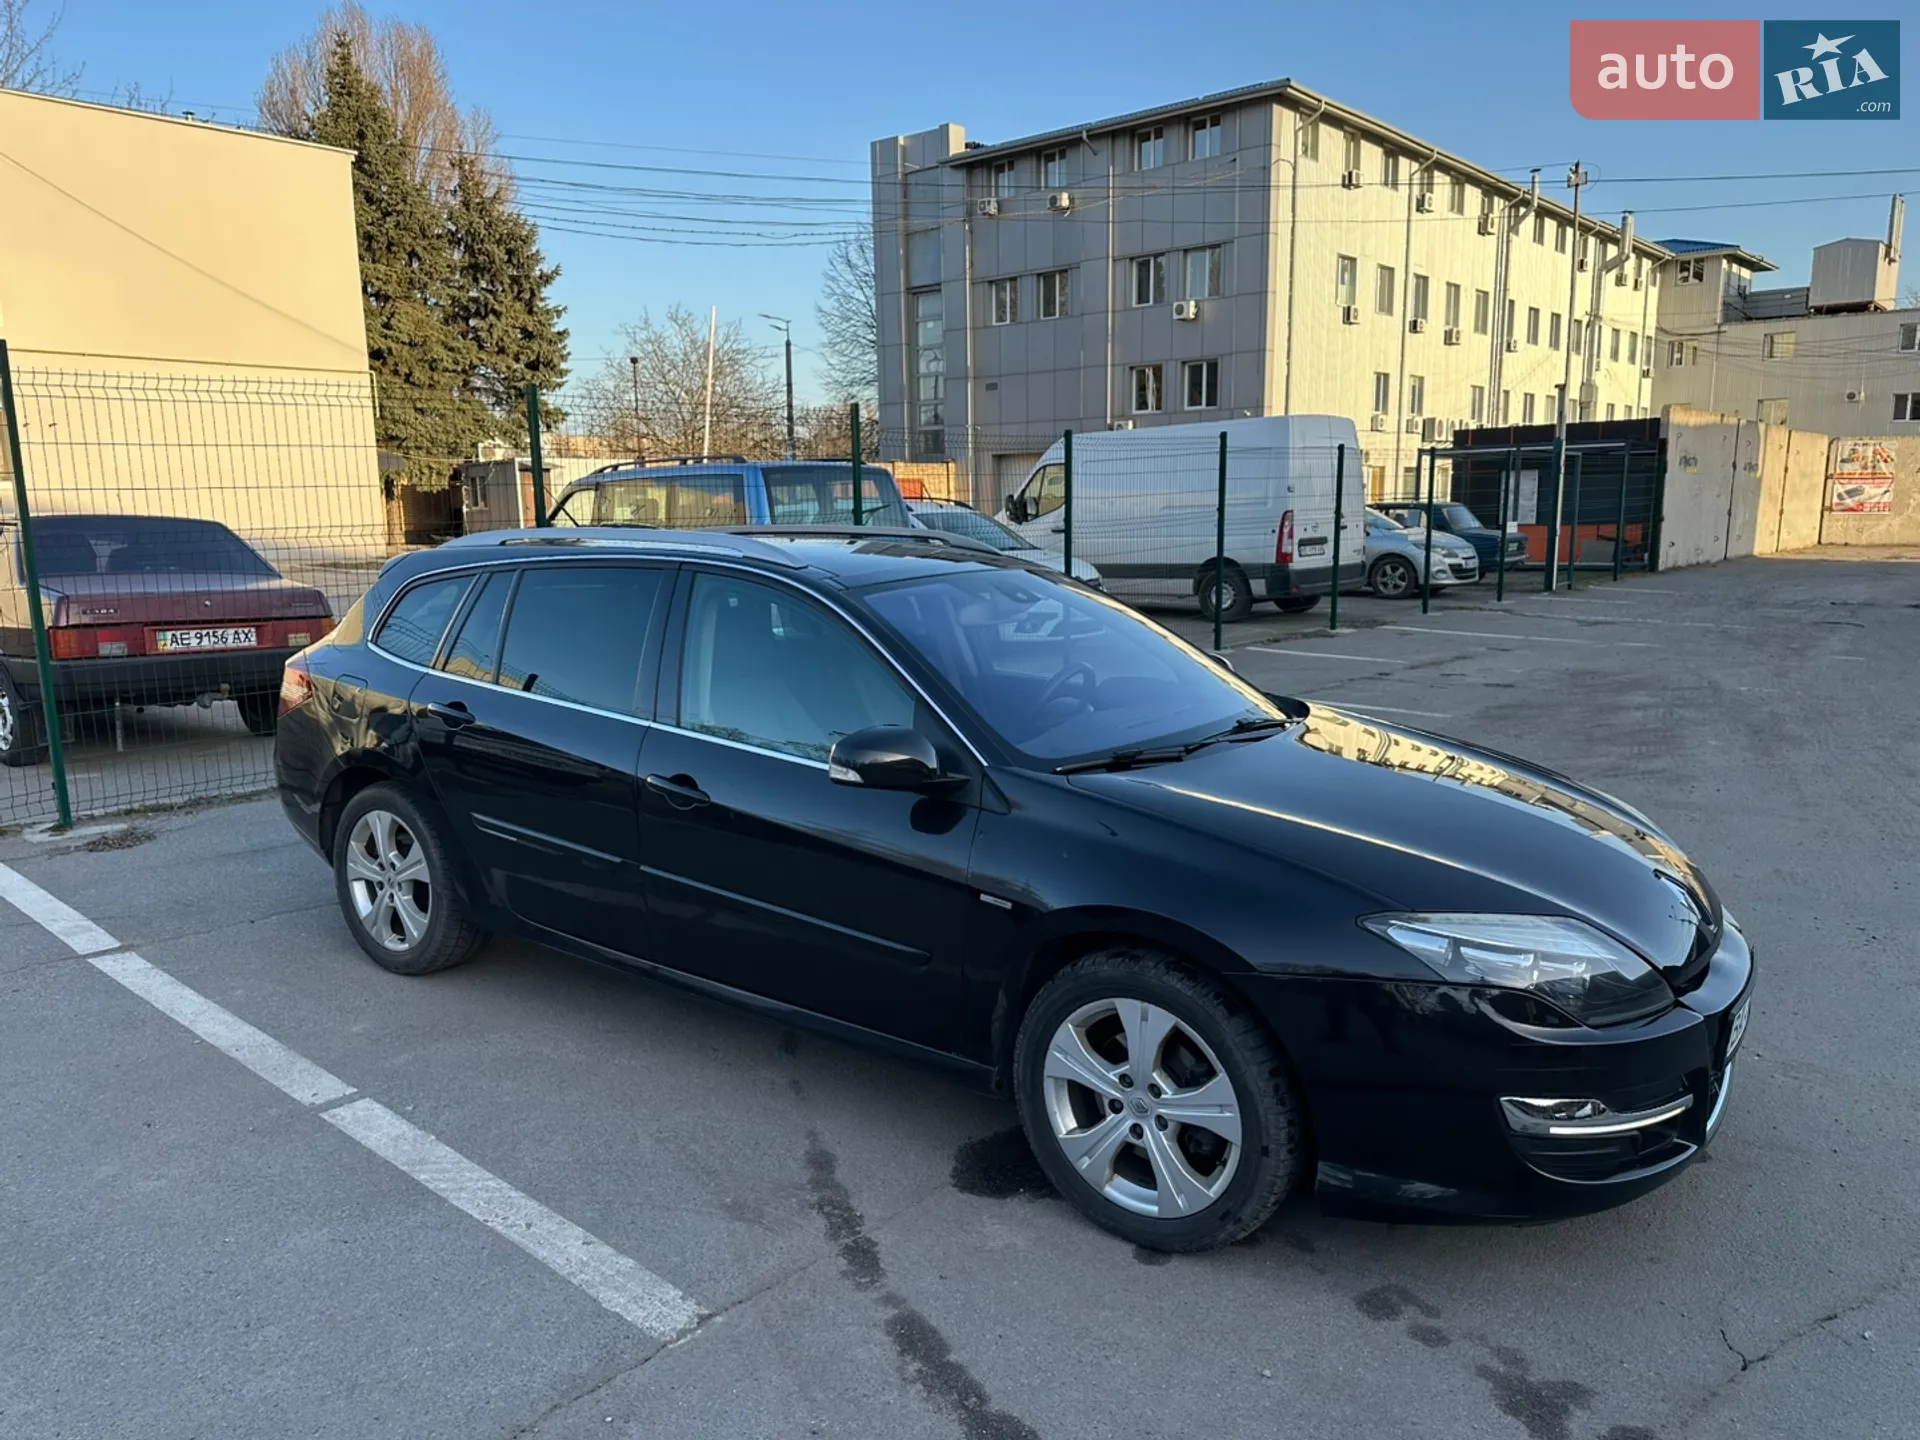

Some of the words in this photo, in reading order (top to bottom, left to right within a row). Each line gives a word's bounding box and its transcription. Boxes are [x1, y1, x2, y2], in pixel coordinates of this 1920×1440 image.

[170, 632, 191, 647] AE
[194, 630, 229, 645] 9156
[232, 629, 252, 645] AX
